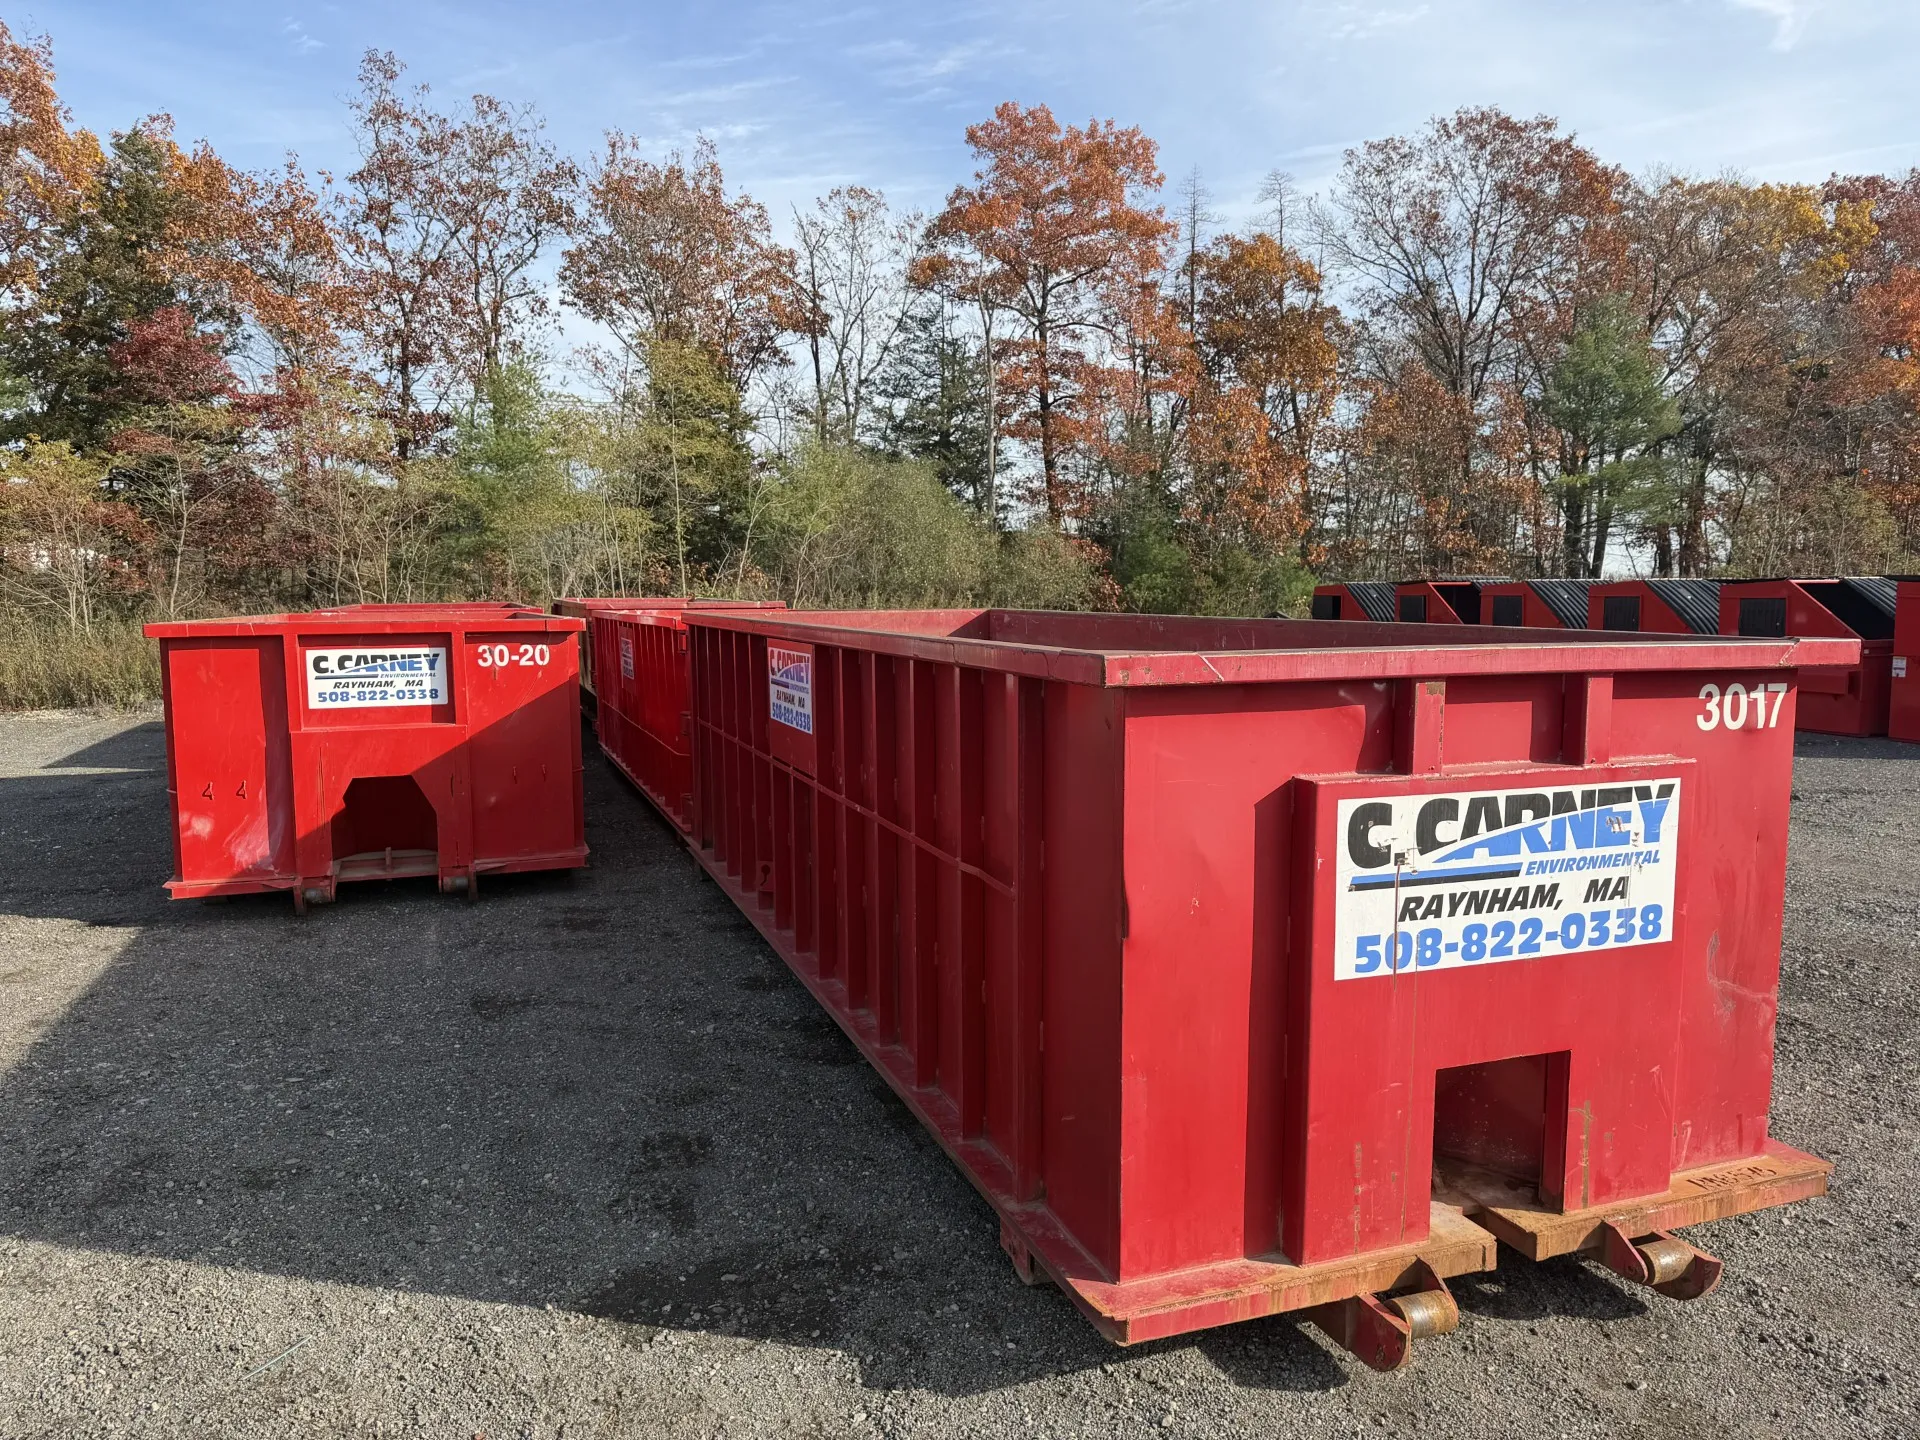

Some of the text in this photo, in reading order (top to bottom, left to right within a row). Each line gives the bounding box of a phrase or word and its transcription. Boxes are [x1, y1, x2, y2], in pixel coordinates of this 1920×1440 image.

[477, 644, 550, 667] 30-20
[318, 688, 439, 703] 508-822-0338
[333, 679, 424, 689] RAYNHAM, MA
[1696, 682, 1788, 731] 3017
[1525, 849, 1661, 876] ENVIRONMENTAL
[1399, 876, 1629, 922] RAYNHAM, MA
[1353, 903, 1664, 974] 508-822-0338
